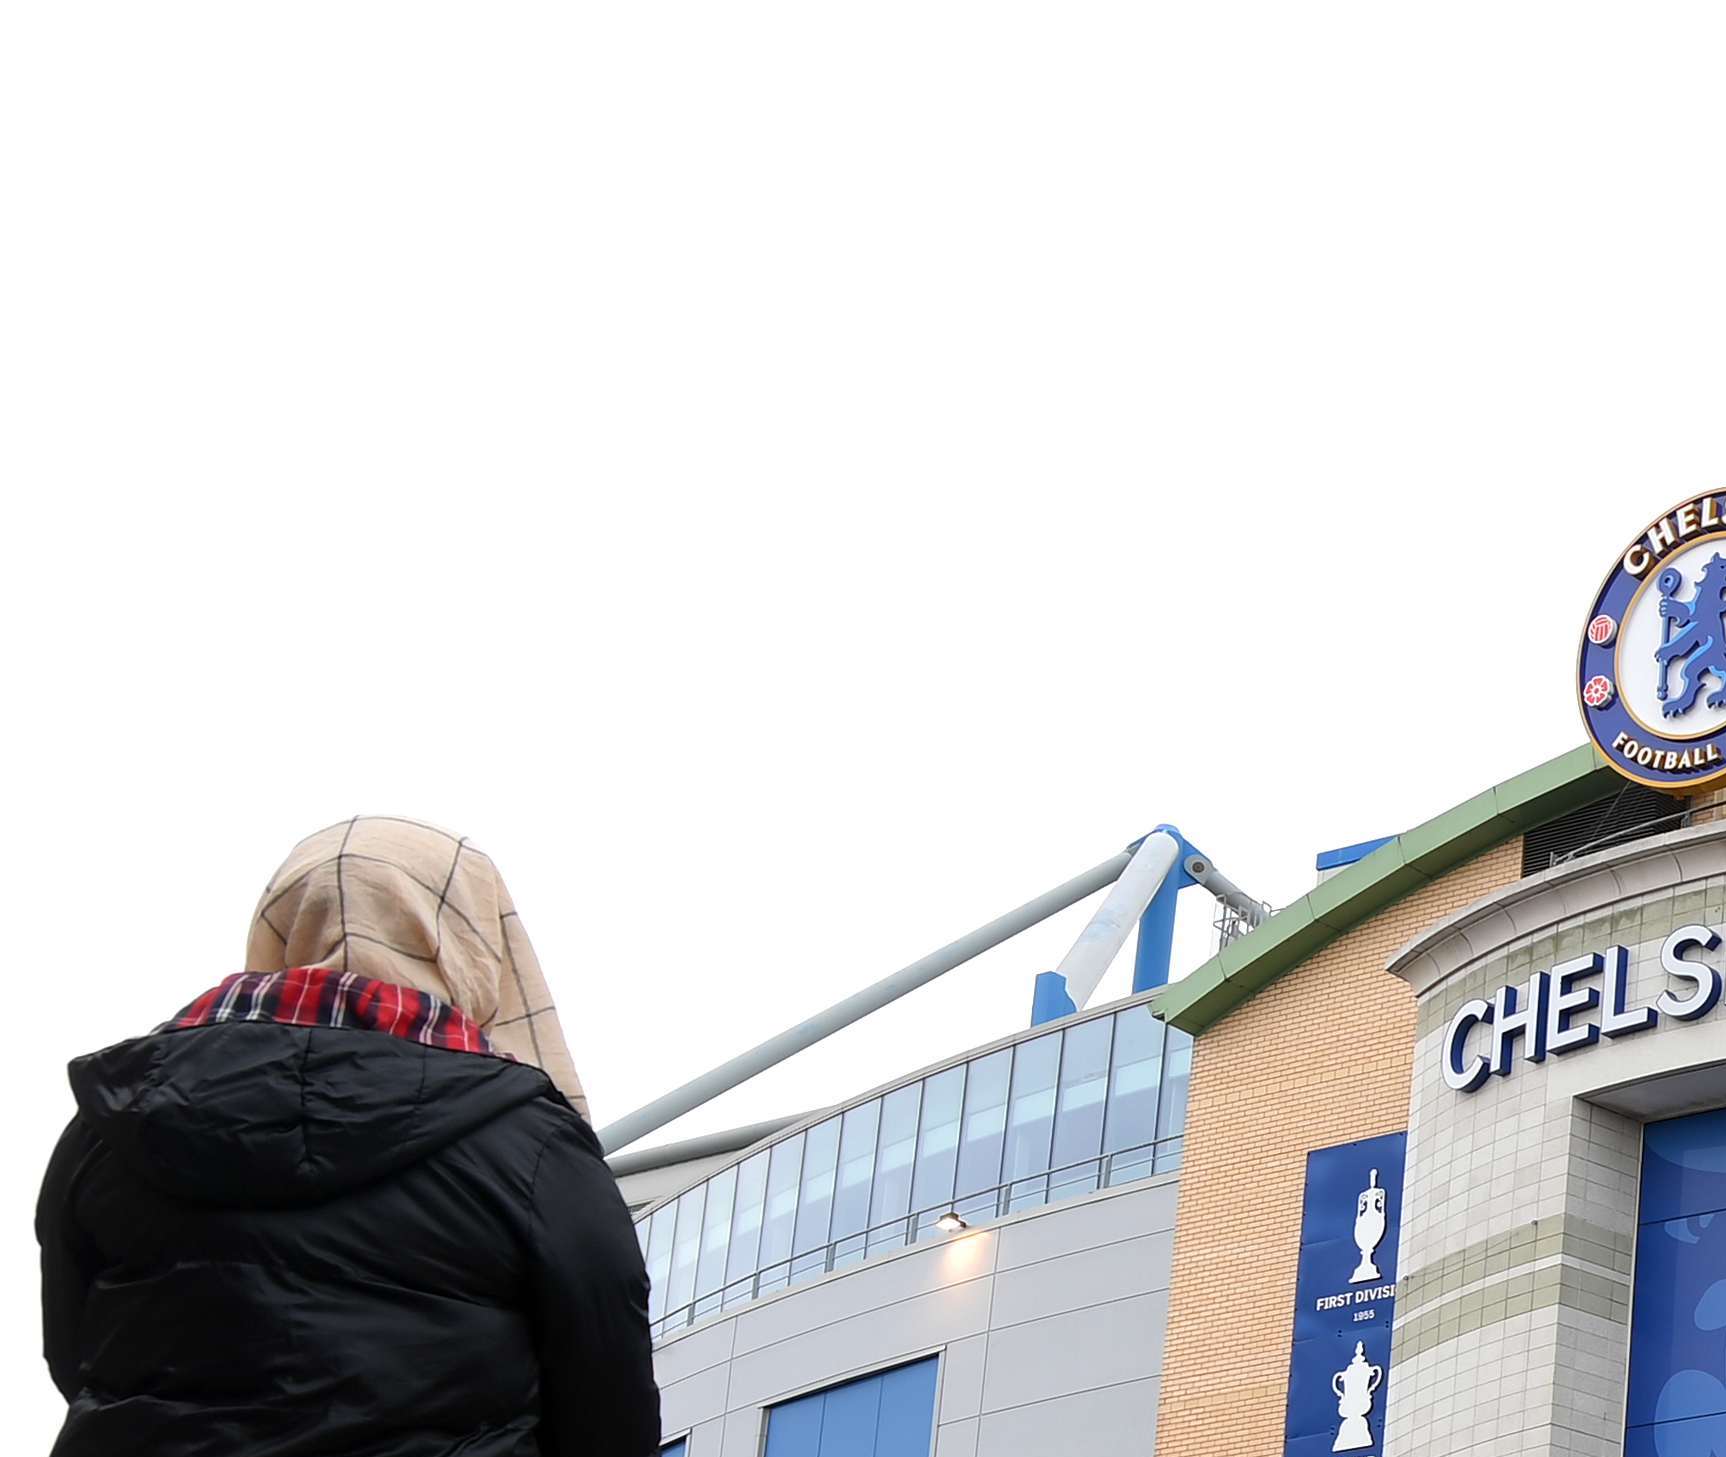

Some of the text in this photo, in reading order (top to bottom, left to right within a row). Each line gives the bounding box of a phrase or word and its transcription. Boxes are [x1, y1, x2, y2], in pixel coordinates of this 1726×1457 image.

[1611, 731, 1721, 771] FOOTBALL
[1316, 1284, 1395, 1311] FIRST DIVISI
[1353, 1309, 1375, 1322] 1955
